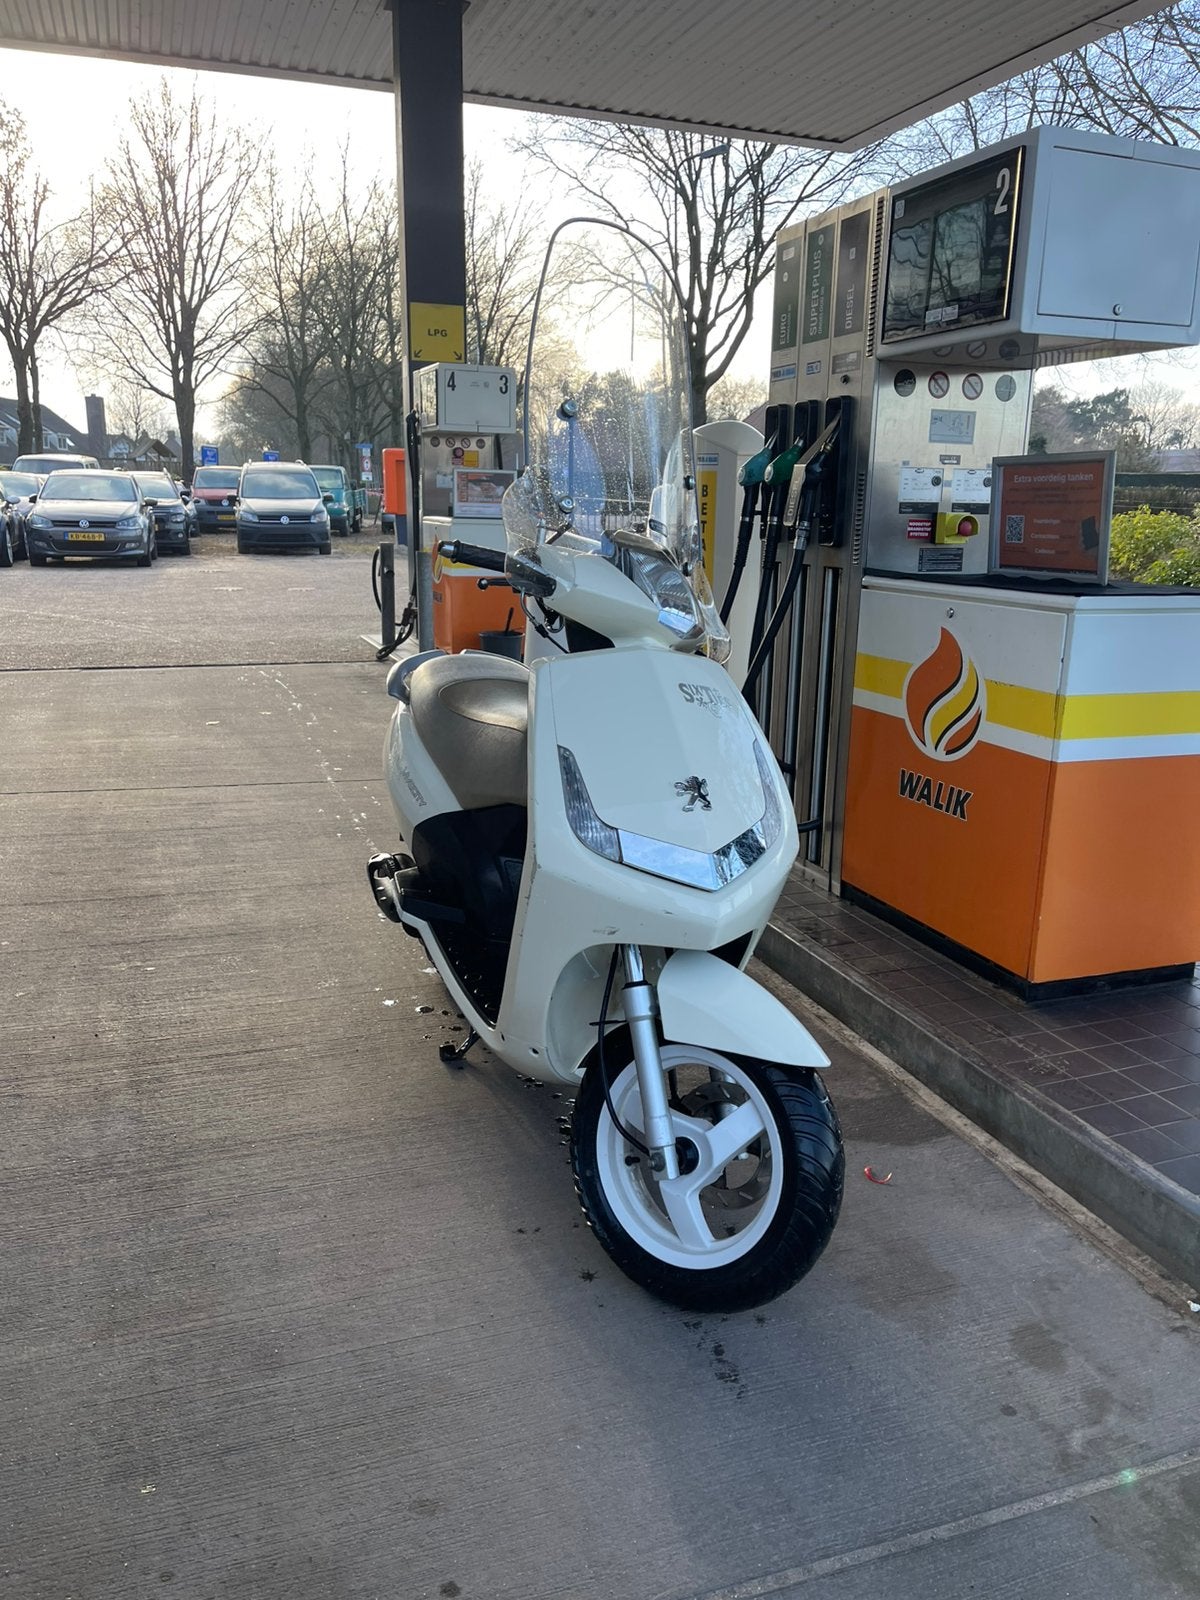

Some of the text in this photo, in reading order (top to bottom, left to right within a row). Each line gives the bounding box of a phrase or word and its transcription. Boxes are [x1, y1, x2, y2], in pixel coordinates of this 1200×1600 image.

[994, 167, 1011, 215] 2
[812, 250, 822, 288] PLUS
[809, 289, 820, 336] SUPER
[845, 283, 855, 329] DIESEL
[427, 328, 448, 337] LPG
[780, 313, 788, 345] EURO
[447, 371, 456, 391] 4
[499, 375, 508, 395] 3
[1014, 473, 1094, 483] Extra voordelig tanken
[787, 480, 800, 517] DIESEL
[899, 768, 974, 822] WALIK
